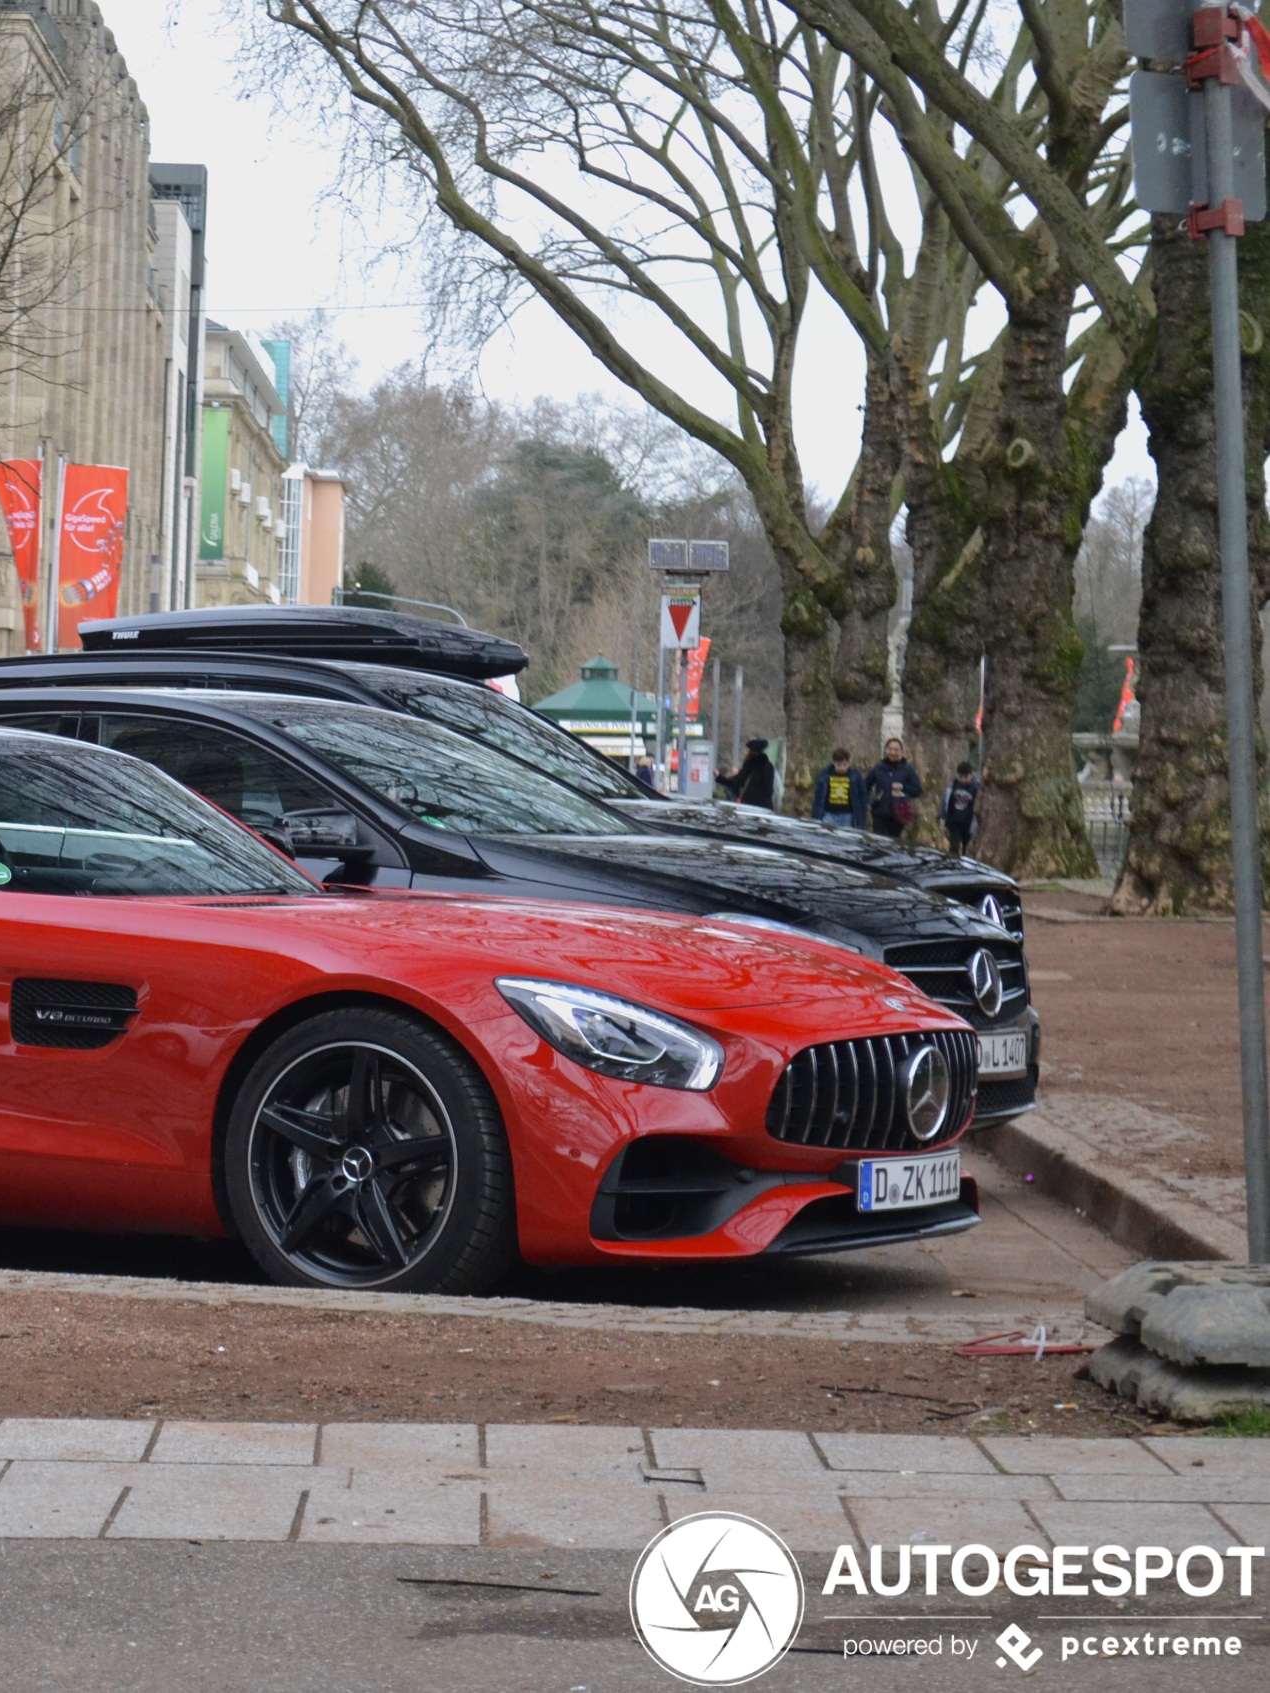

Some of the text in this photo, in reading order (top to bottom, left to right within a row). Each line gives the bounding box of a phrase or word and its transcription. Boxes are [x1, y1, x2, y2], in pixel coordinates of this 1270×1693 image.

[112, 630, 140, 640] THULE
[35, 1010, 112, 1024] V8 BITURBO
[992, 1039, 1000, 1067] L
[1002, 1037, 1025, 1067] 1407
[874, 1159, 959, 1203] D ZK 1111
